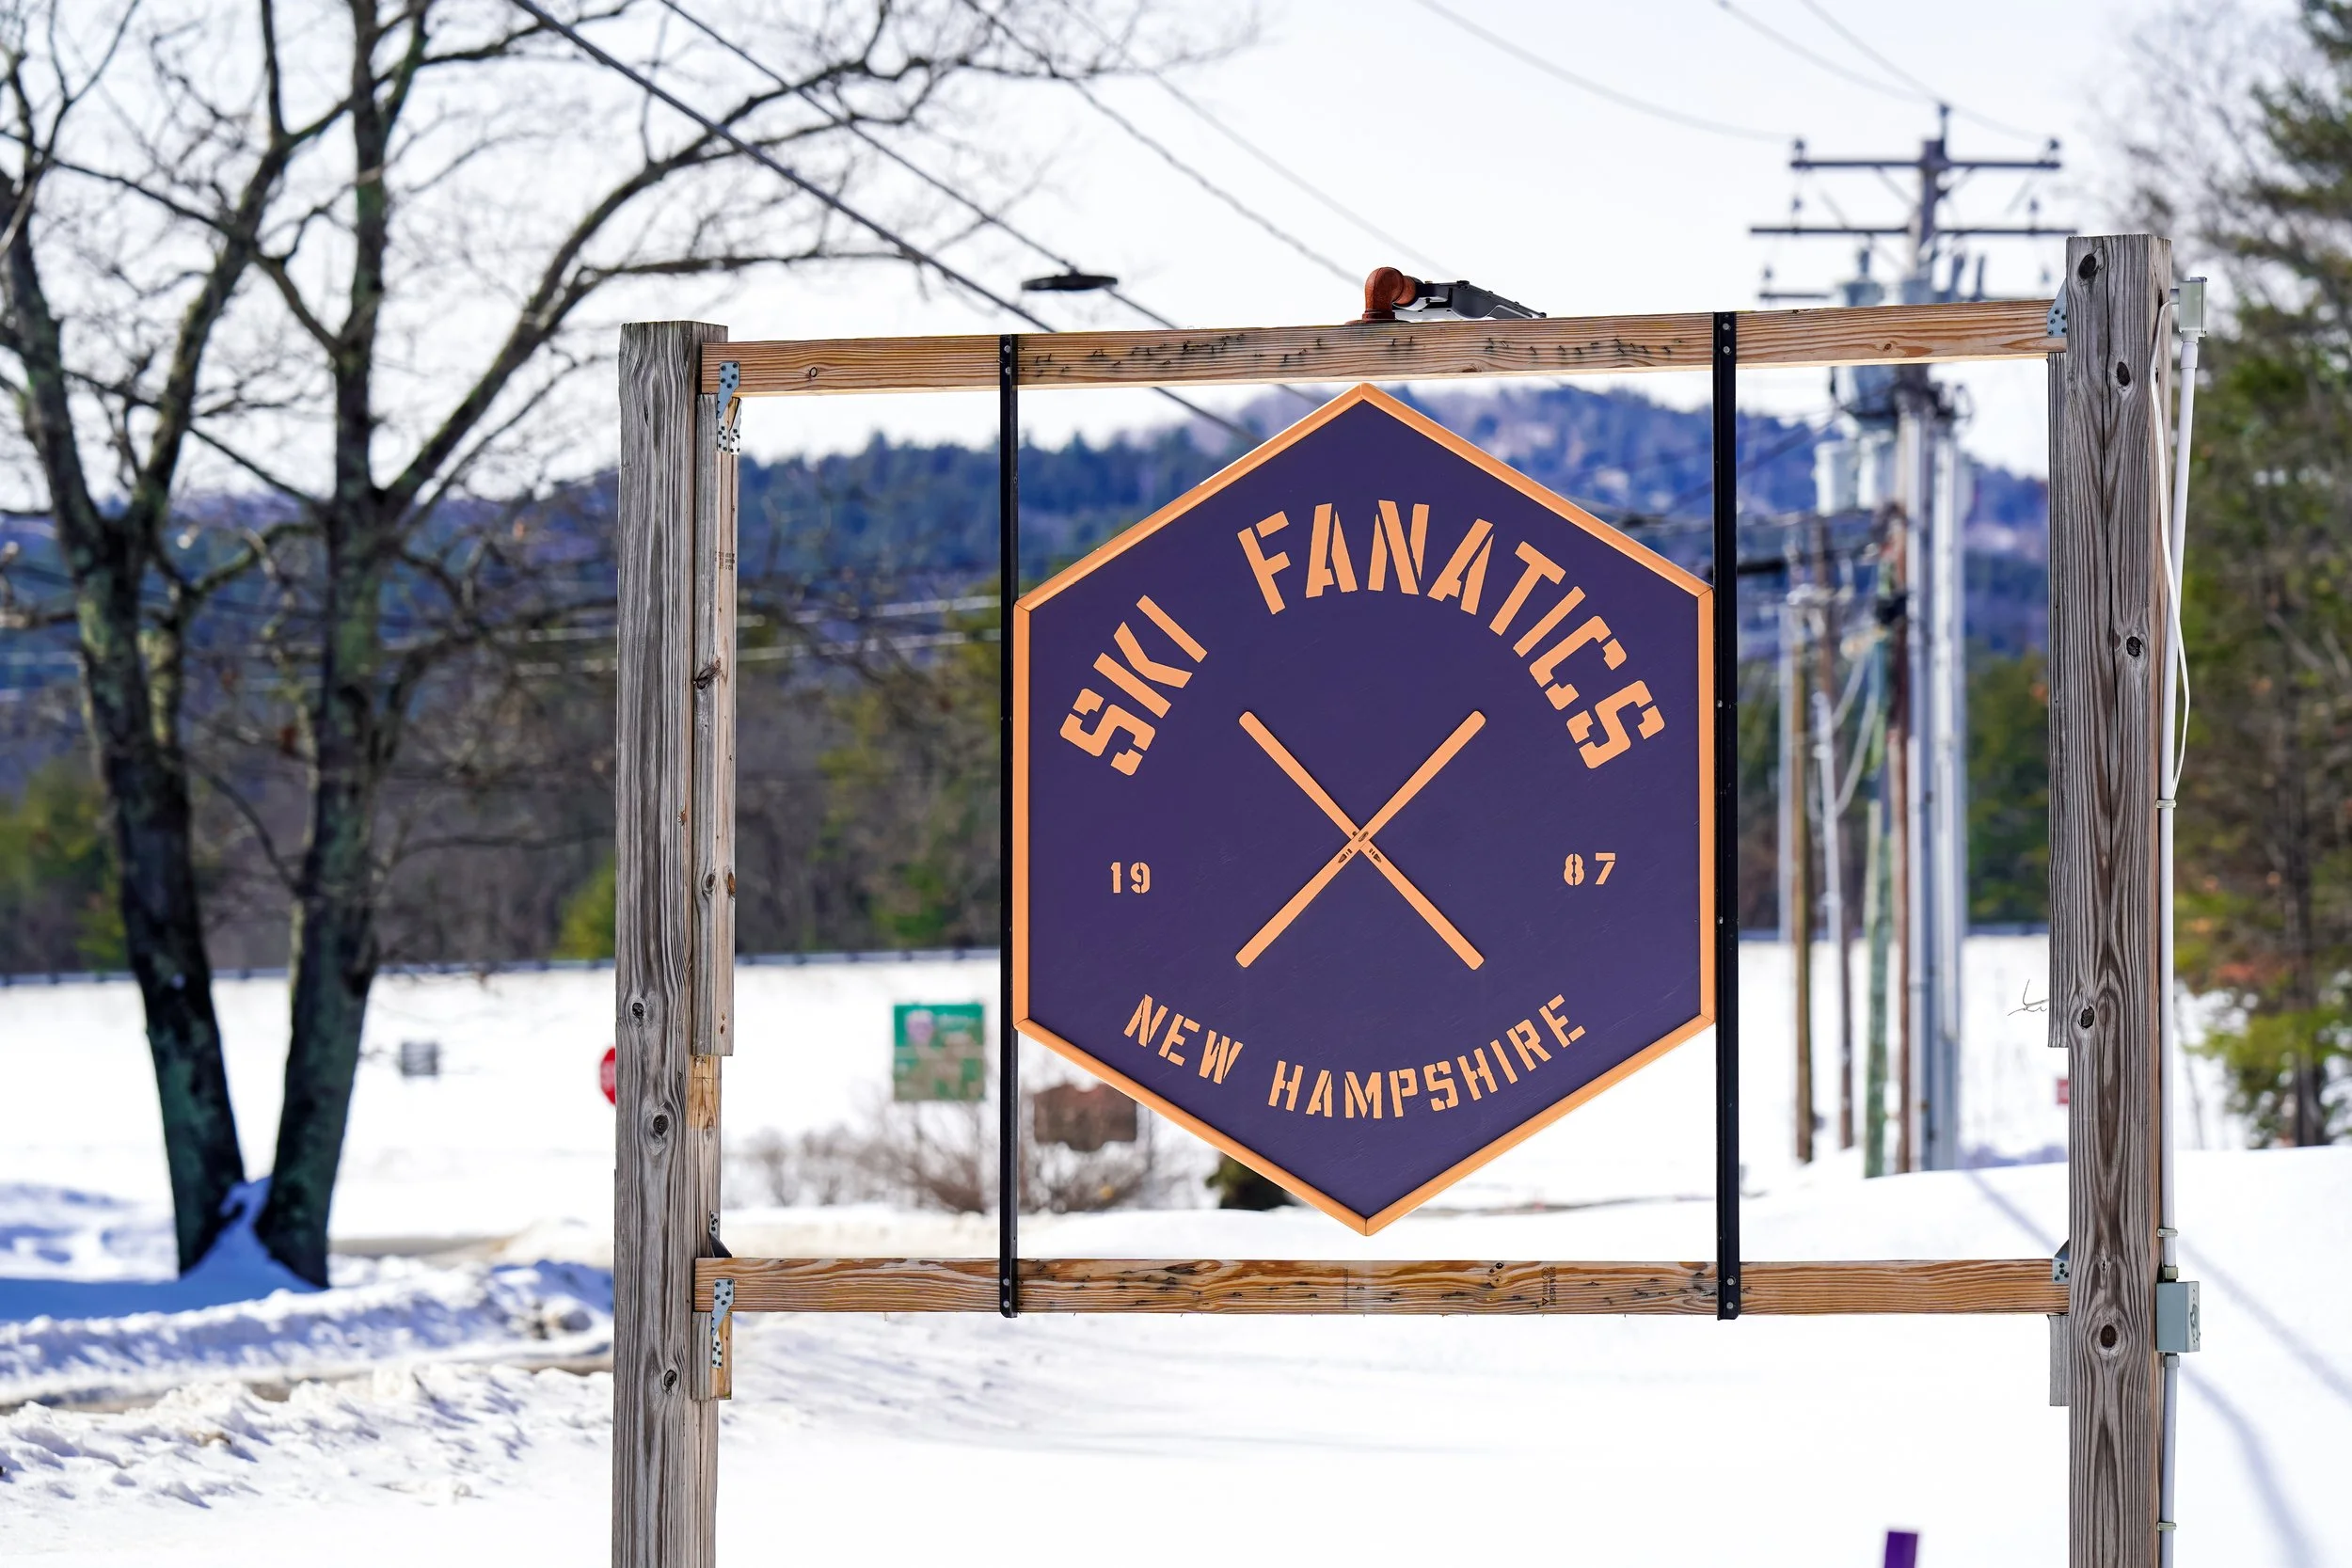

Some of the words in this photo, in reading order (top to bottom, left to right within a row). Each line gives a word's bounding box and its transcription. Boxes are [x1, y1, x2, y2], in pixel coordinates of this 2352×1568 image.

[1059, 594, 1208, 776] SKI
[1237, 499, 1665, 769] FANATICS
[1110, 861, 1152, 895] 19
[1563, 851, 1616, 887] 87
[1123, 994, 1243, 1085] NEW
[1268, 994, 1586, 1119] HAMPSHIRE
